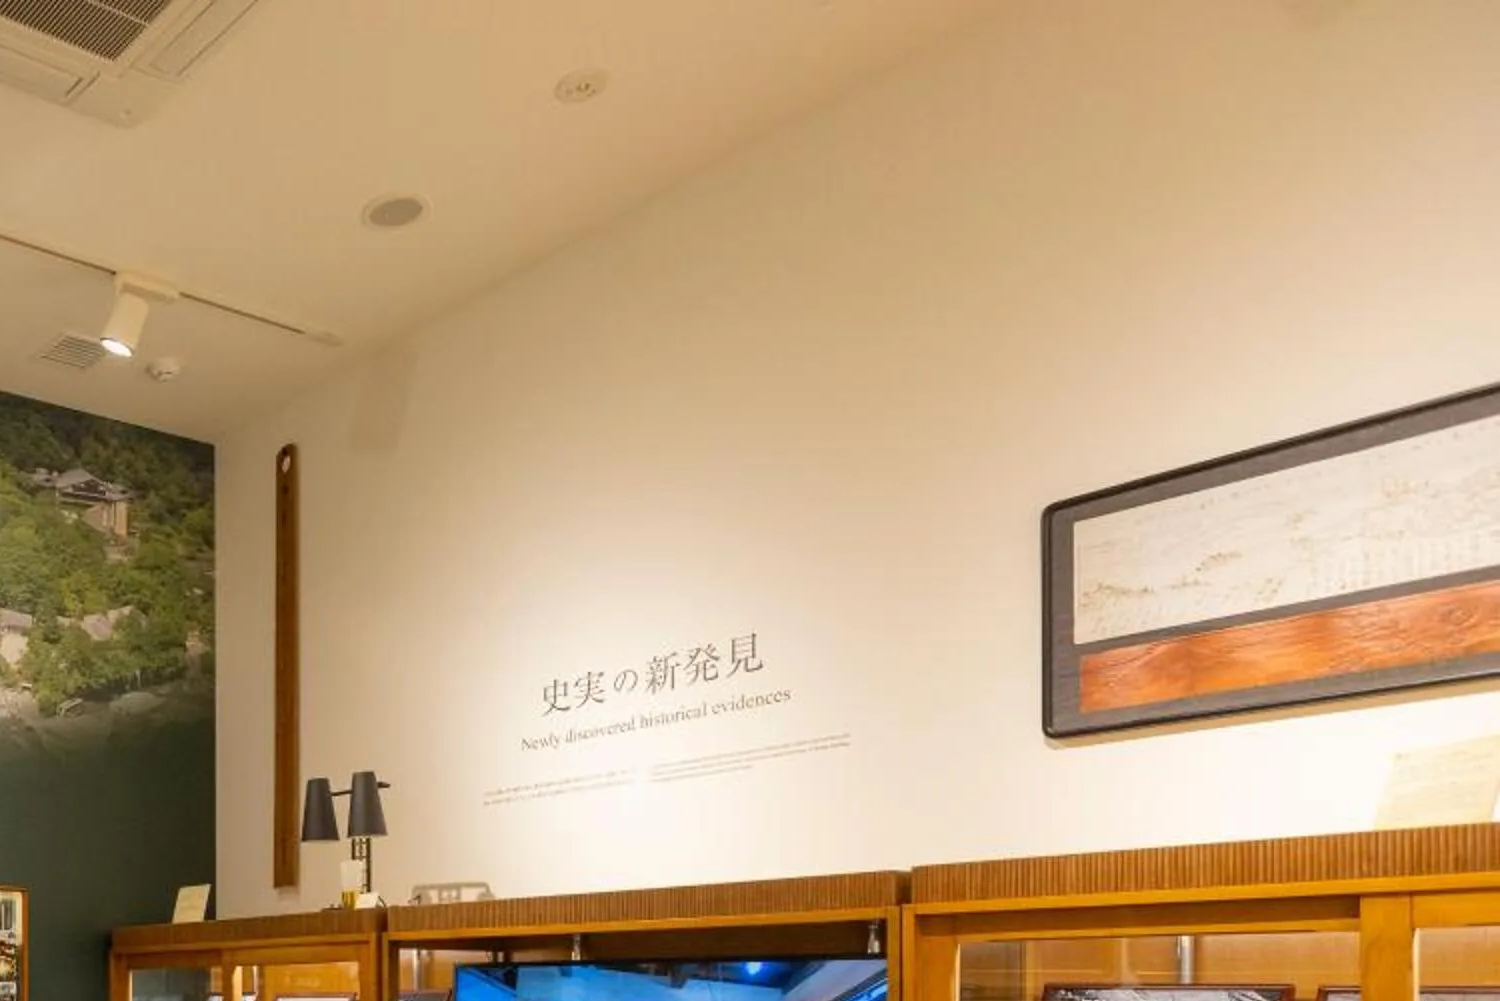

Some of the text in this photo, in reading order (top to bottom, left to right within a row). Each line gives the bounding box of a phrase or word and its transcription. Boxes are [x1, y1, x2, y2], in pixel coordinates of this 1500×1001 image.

[541, 633, 764, 717] 史実の新発見
[521, 688, 792, 751] Newly discovered historical evidences
